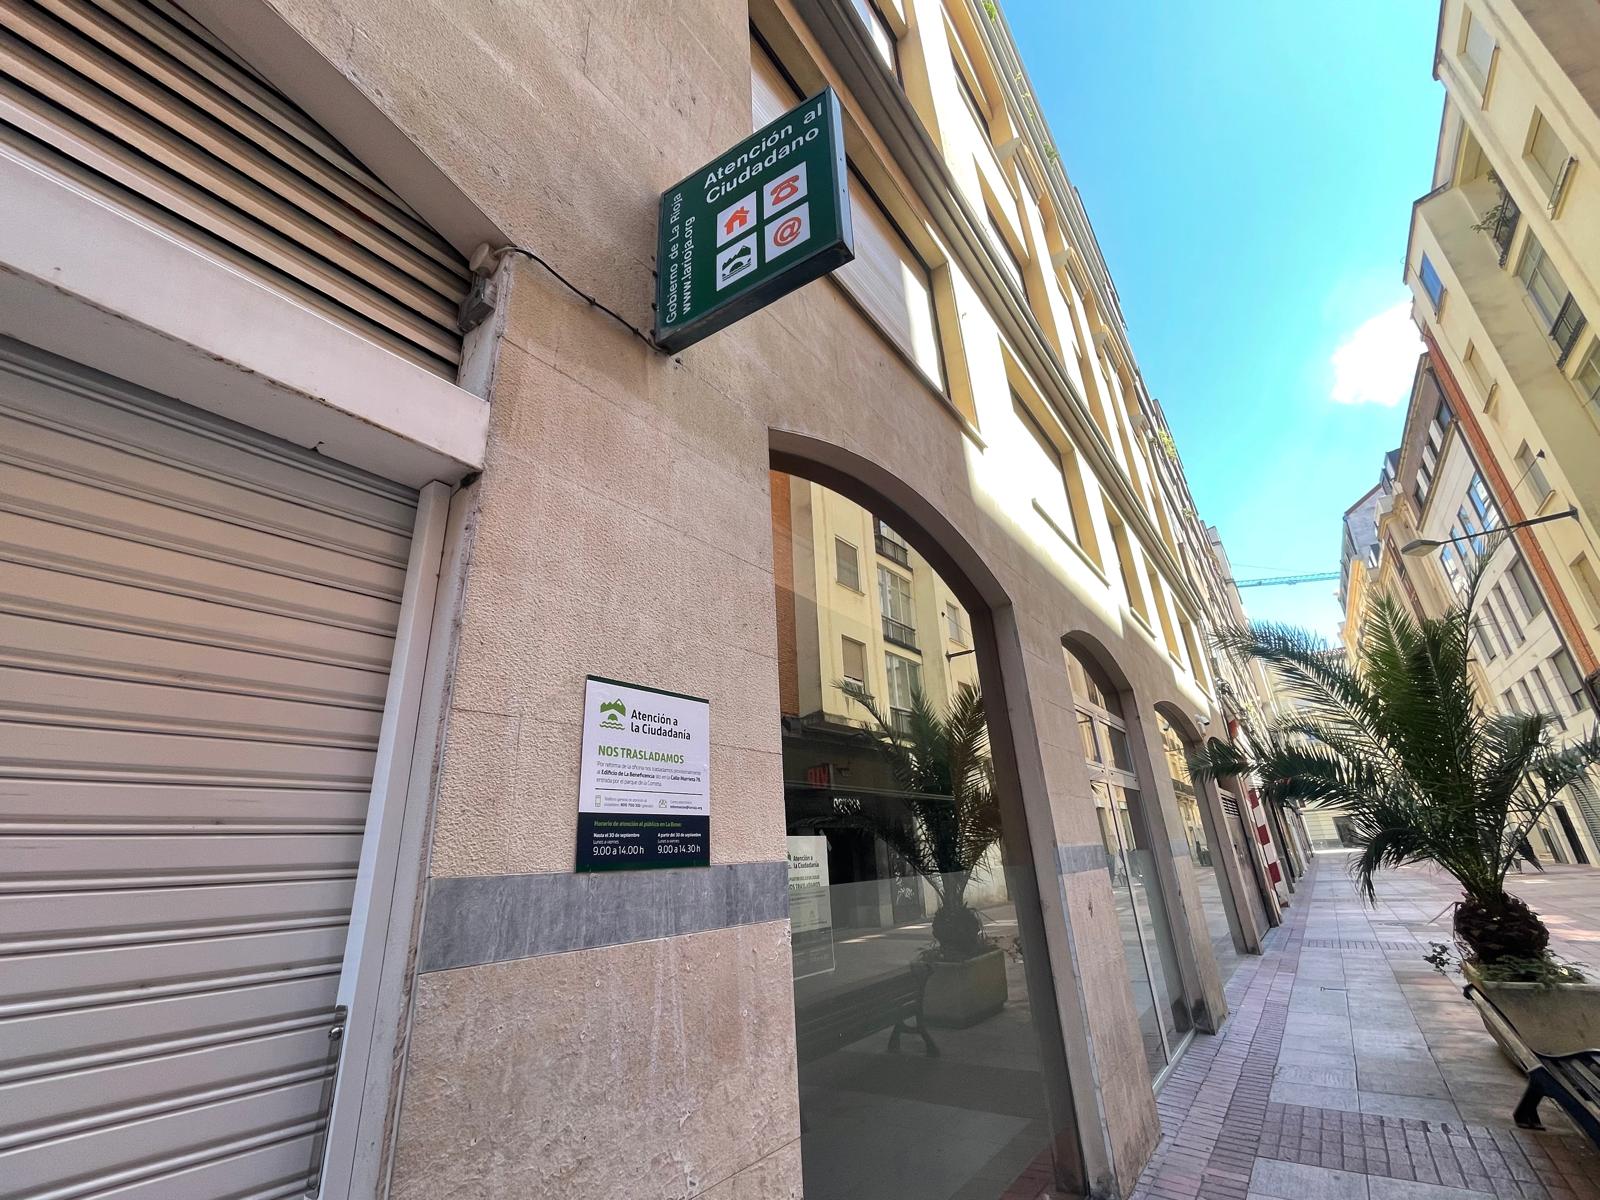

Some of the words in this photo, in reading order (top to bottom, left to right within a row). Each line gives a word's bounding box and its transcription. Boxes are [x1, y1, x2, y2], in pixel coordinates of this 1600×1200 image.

[704, 122, 793, 190] Atención
[803, 102, 822, 125] al
[705, 126, 820, 205] Ciudadano
[670, 192, 683, 223] Rioja
[669, 224, 680, 242] La
[669, 243, 679, 260] de
[681, 216, 696, 315] www.larioja.org
[666, 263, 678, 324] Gobierno
[631, 709, 671, 725] Atención
[673, 718, 678, 726] a
[631, 722, 640, 733] la
[642, 724, 691, 740] Ciudadanía
[598, 745, 619, 757] NOS
[621, 747, 685, 764] TRASLADAMOS
[593, 846, 611, 855] 9.00
[612, 847, 617, 855] a
[618, 845, 639, 855] 14.00
[640, 845, 645, 854] h
[658, 845, 674, 854] 9.00
[674, 846, 678, 854] a
[679, 844, 695, 853] 14.30
[696, 844, 701, 853] h
